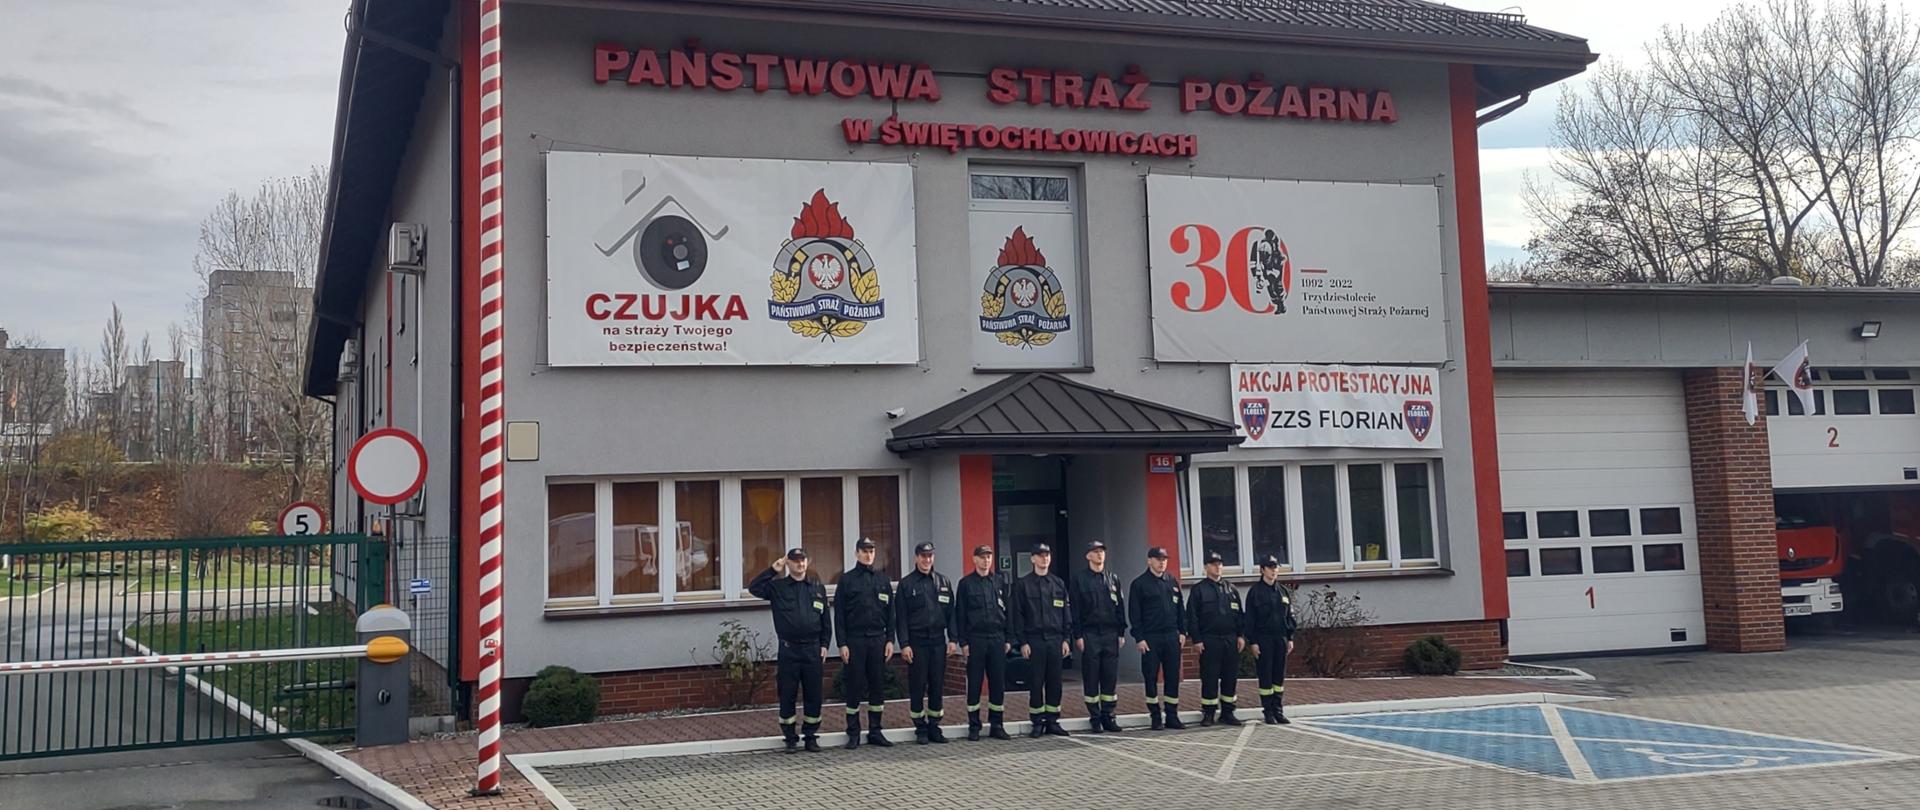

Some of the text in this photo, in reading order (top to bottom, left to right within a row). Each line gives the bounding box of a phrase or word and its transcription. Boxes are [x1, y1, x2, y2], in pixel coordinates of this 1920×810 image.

[594, 39, 1397, 124] PAŃSTWOWA STRAŻ POŻARNA
[841, 114, 1197, 157] W ŚWIĘTOCHŁOWICACH
[1169, 224, 1291, 314] 30
[1301, 278, 1353, 288] 1992 2022
[585, 293, 749, 321] CZUJKA
[1302, 292, 1377, 304] Trzydziestolecie
[771, 299, 881, 318] PAŃSTWOWA STRAŻ POŻARNA
[1302, 305, 1429, 318] Państwowej Straży Pożarnej
[603, 325, 733, 338] na straży Twojego
[609, 341, 727, 354] bezpieczeństwa!
[1239, 371, 1433, 395] AKCJA PROTESTACYJNA
[1271, 410, 1404, 430] ZZS FLORIAN
[1827, 427, 1840, 448] 2
[1156, 457, 1169, 465] 16
[295, 514, 309, 535] 5
[1584, 587, 1595, 609] 1
